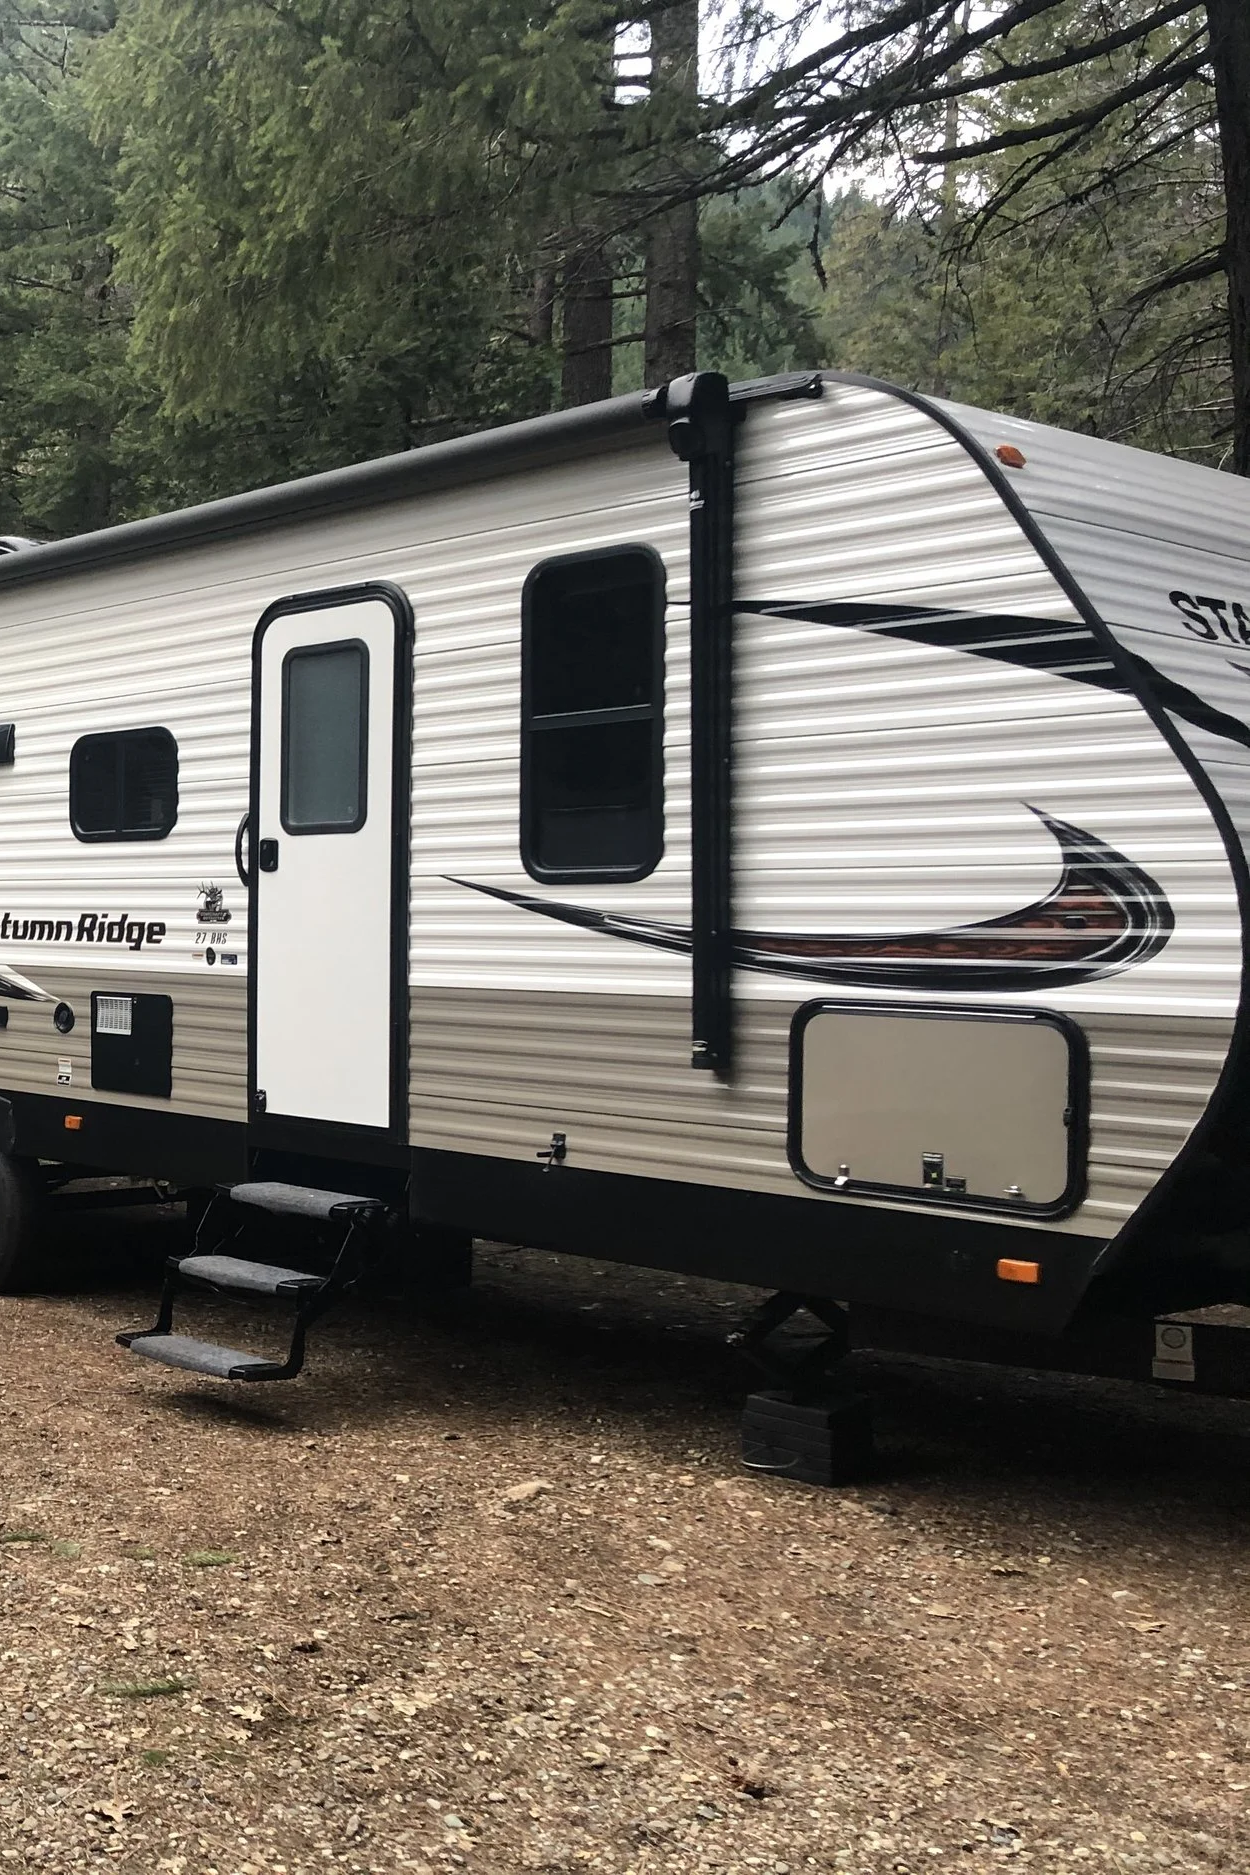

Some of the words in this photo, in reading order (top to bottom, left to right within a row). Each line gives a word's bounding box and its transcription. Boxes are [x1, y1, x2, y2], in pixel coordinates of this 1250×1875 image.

[75, 913, 166, 951] Ridge
[195, 932, 207, 944] 27
[210, 932, 228, 945] BHS
